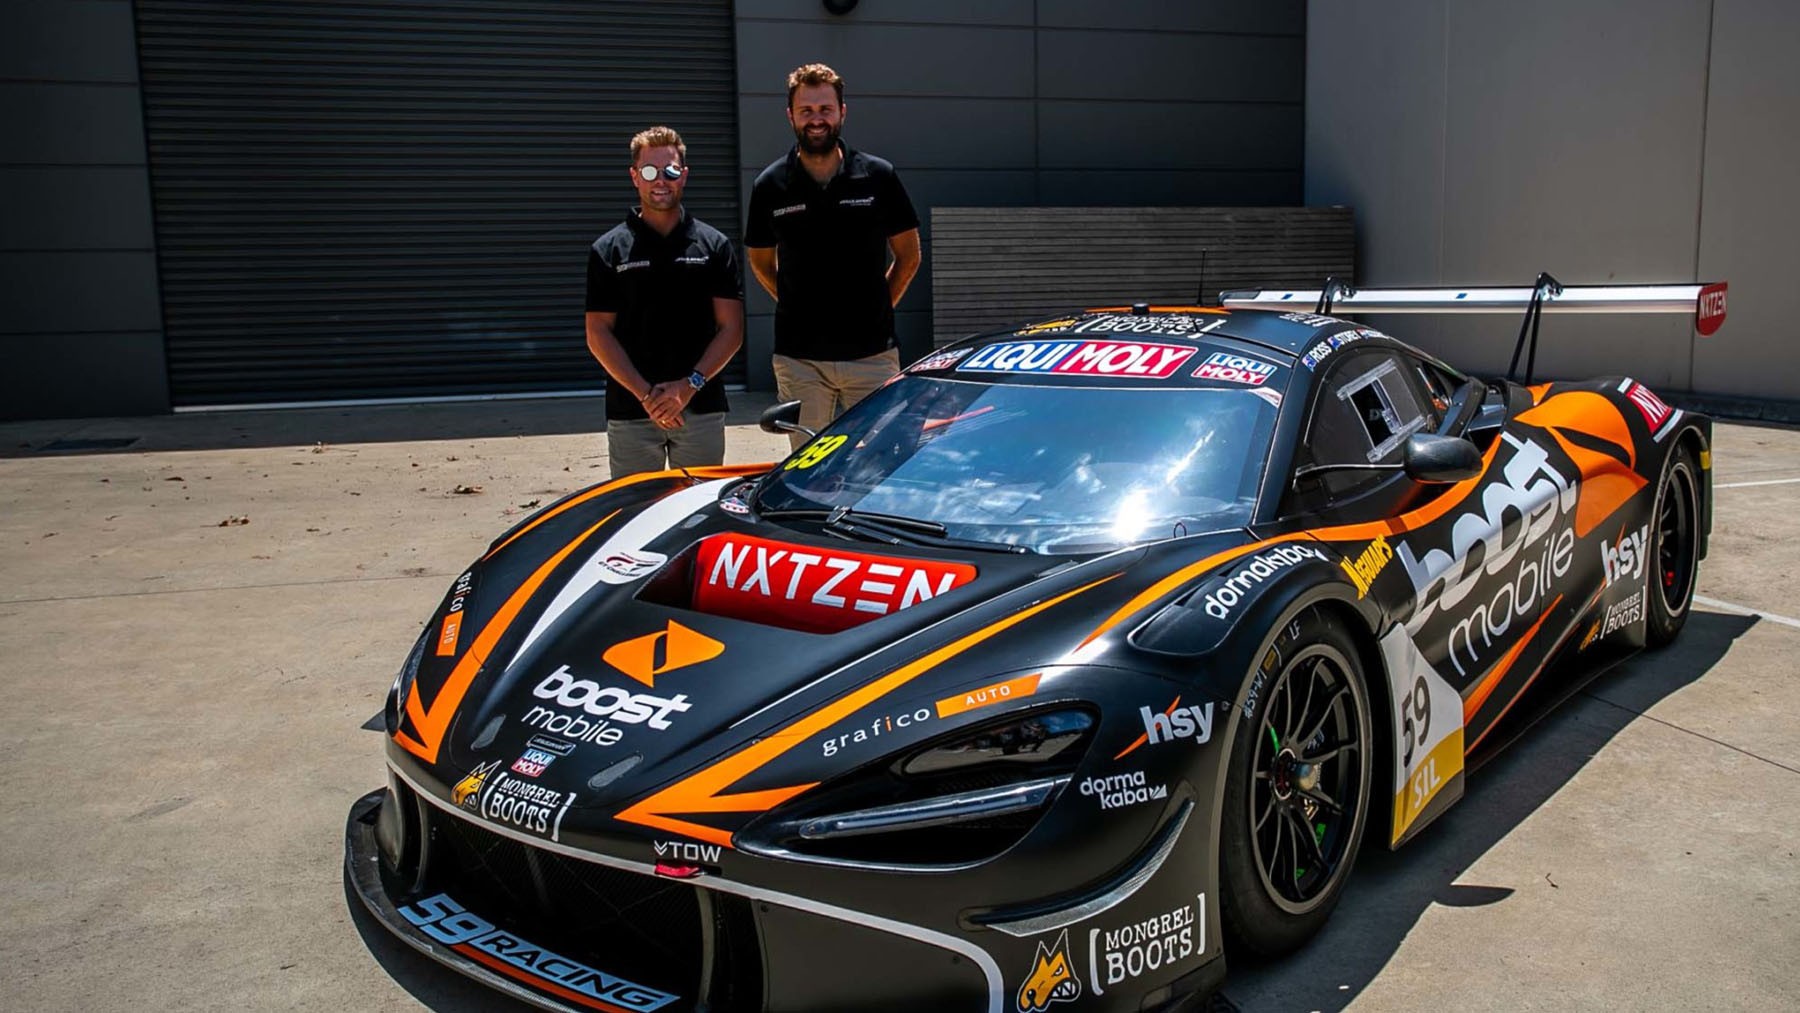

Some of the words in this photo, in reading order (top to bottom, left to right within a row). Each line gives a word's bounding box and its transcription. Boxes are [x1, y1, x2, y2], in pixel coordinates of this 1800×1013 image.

[1699, 290, 1728, 320] NXTZEN
[969, 343, 1076, 371] LIQUI
[1053, 346, 1188, 376] MOLY
[1208, 353, 1276, 373] LIQUI
[1309, 341, 1332, 362] ROSS
[1200, 365, 1265, 384] MOLY
[784, 434, 848, 471] 59
[1396, 430, 1577, 637] boost
[1600, 524, 1649, 589] hsy
[709, 542, 956, 614] NXTZEN
[1448, 526, 1576, 677] mobile
[1606, 604, 1641, 634] BOOTS
[532, 664, 693, 731] boost
[965, 686, 1011, 706] AUTO
[520, 705, 624, 747] mobile
[822, 708, 931, 757] grafico
[1139, 701, 1214, 745] hsy
[1400, 675, 1432, 769] 59
[513, 760, 546, 776] MOLY
[1080, 771, 1146, 796] dorma
[1411, 757, 1441, 809] SIL
[489, 792, 551, 833] BOOTS
[497, 777, 561, 808] MONGREL
[1100, 788, 1149, 810] kaba
[667, 841, 722, 863] TOW
[1105, 905, 1194, 951] MONGREL
[397, 892, 497, 946] 59
[480, 931, 667, 1007] RACING
[1105, 927, 1193, 985] BOOTS
